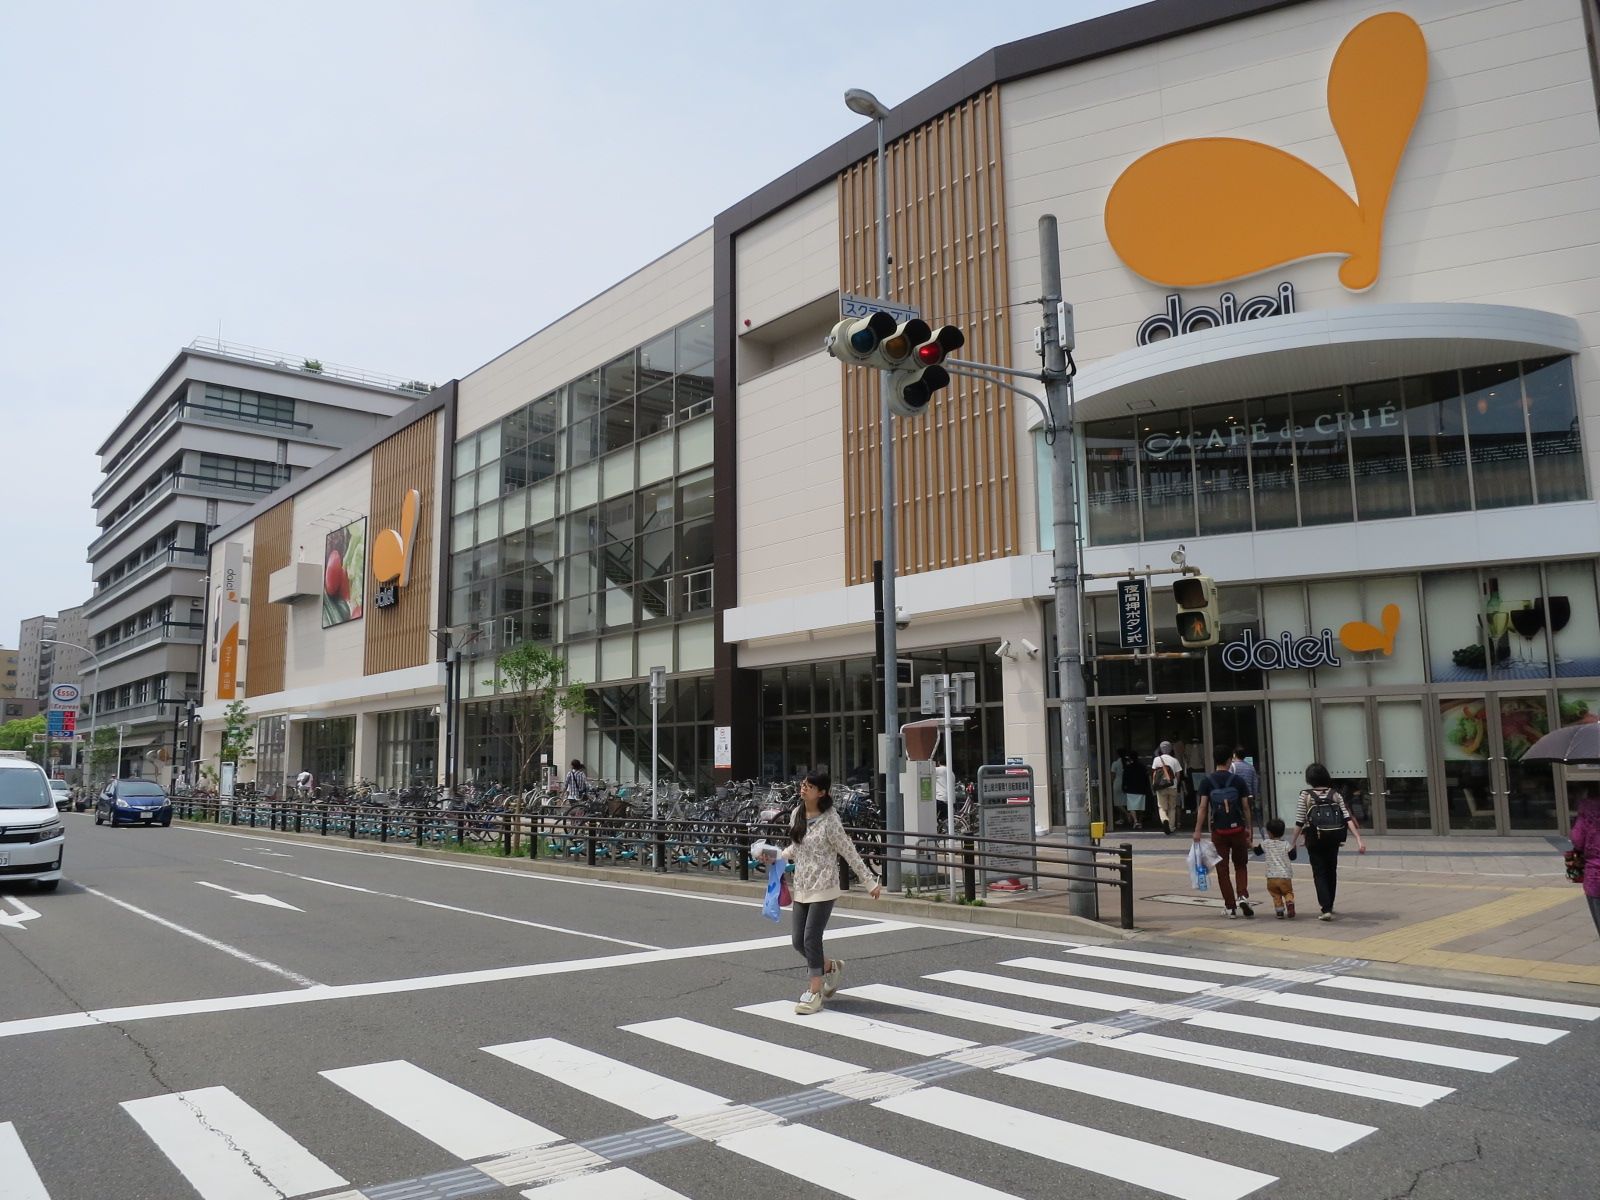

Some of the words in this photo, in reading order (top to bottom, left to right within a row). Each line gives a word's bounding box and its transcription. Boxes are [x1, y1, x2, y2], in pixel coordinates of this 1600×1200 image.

[1186, 418, 1270, 450] CAFÉ
[1280, 419, 1304, 439] de
[1315, 401, 1399, 435] CRIÉ
[1124, 584, 1143, 643] 夜間押ボタン式
[1222, 628, 1341, 671] daiei
[56, 689, 75, 697] Esso
